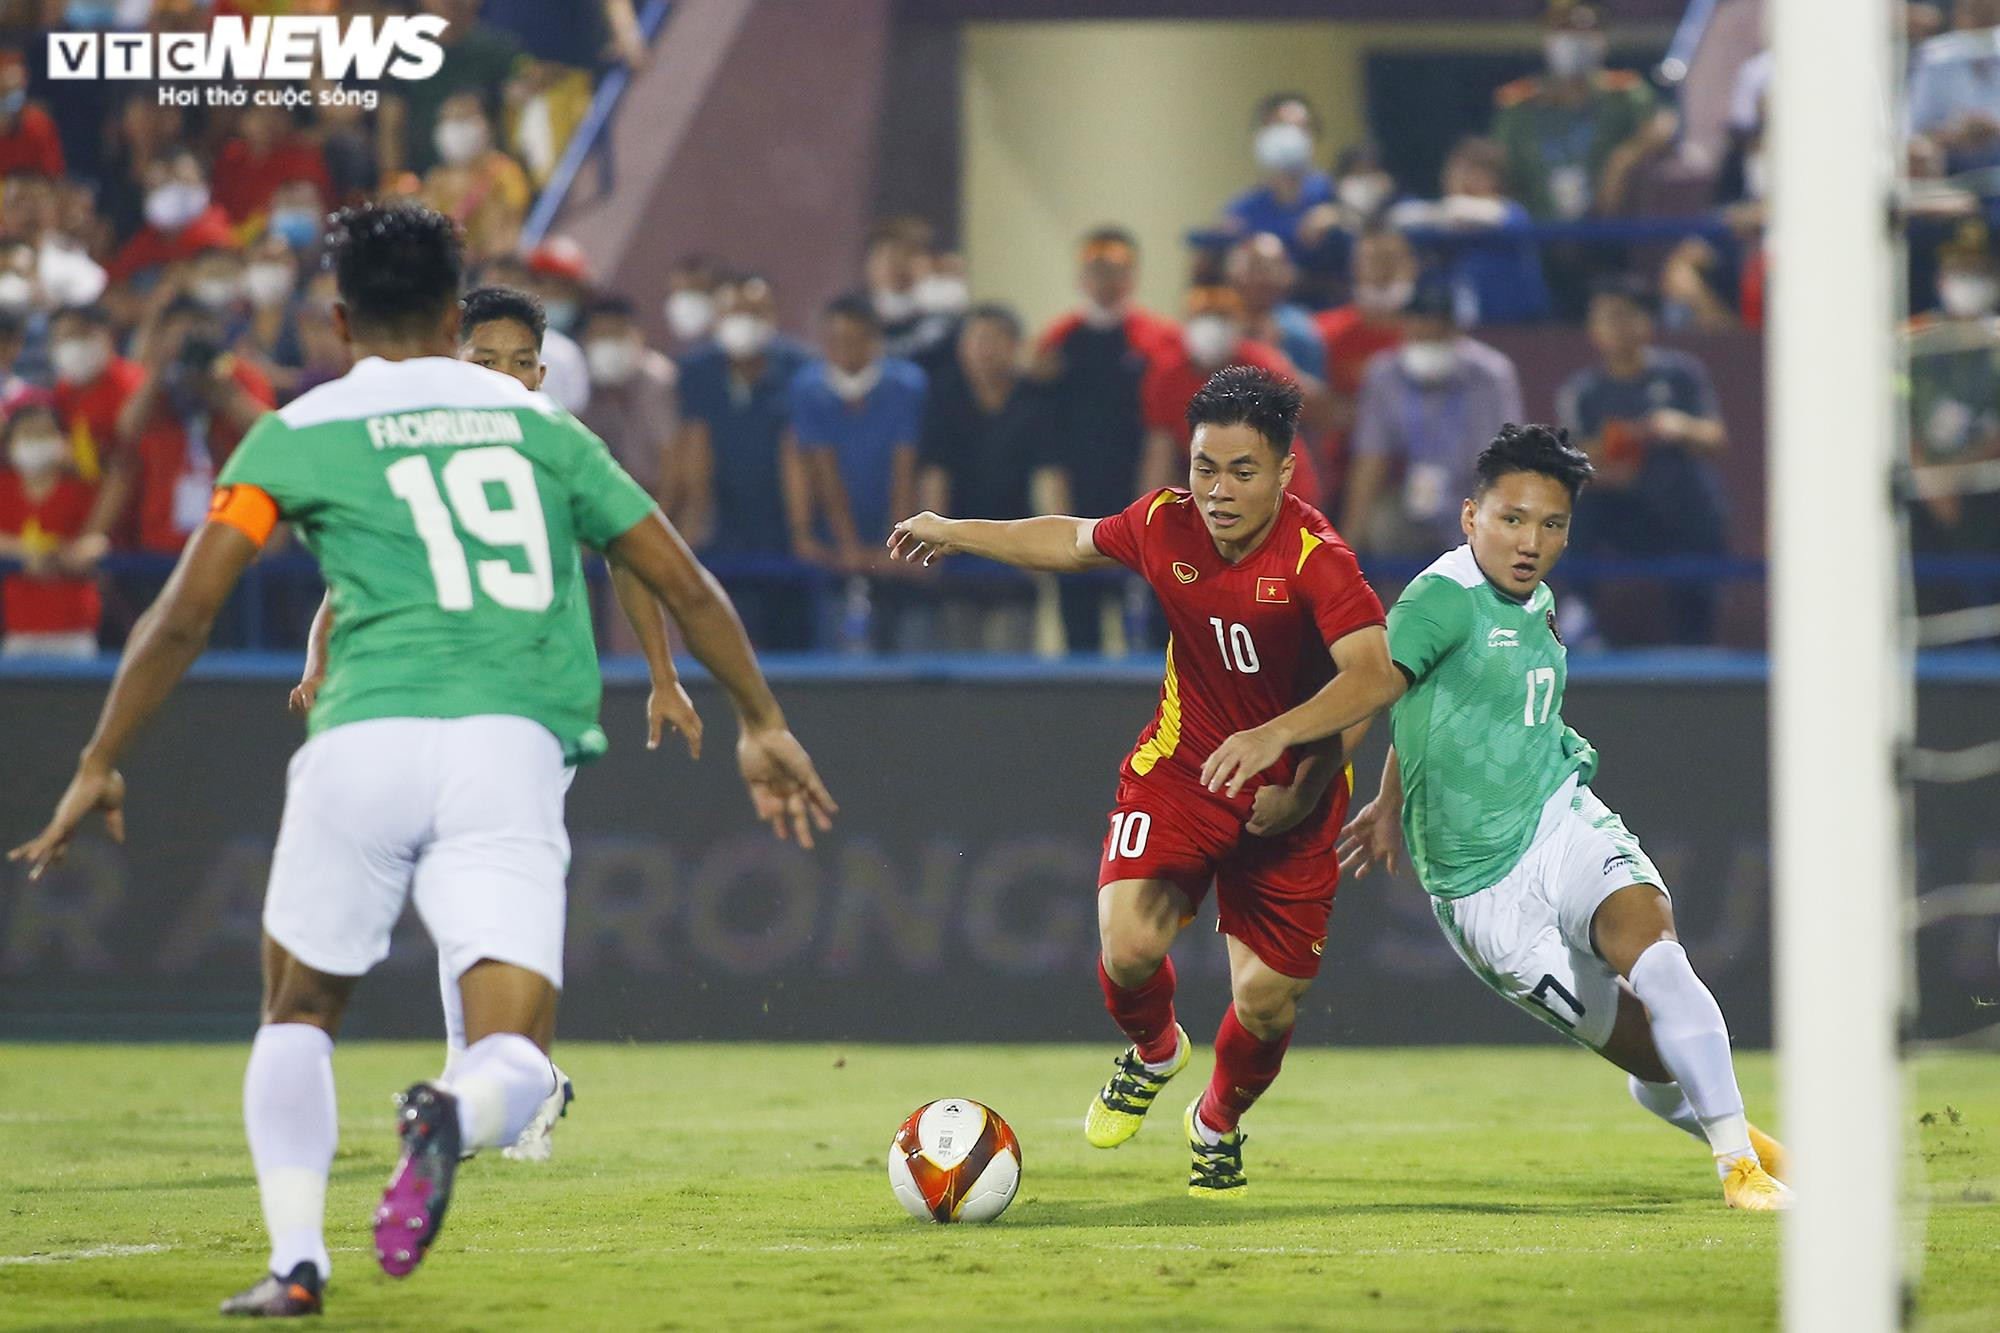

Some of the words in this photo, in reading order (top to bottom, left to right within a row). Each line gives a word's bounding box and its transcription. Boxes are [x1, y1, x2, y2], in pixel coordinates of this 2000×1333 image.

[366, 409, 524, 451] FACHRUDDIN
[384, 445, 554, 613] 19
[1209, 616, 1260, 674] 10
[1524, 667, 1556, 727] 17
[1108, 811, 1151, 862] 10
[1527, 973, 1586, 1029] 17
